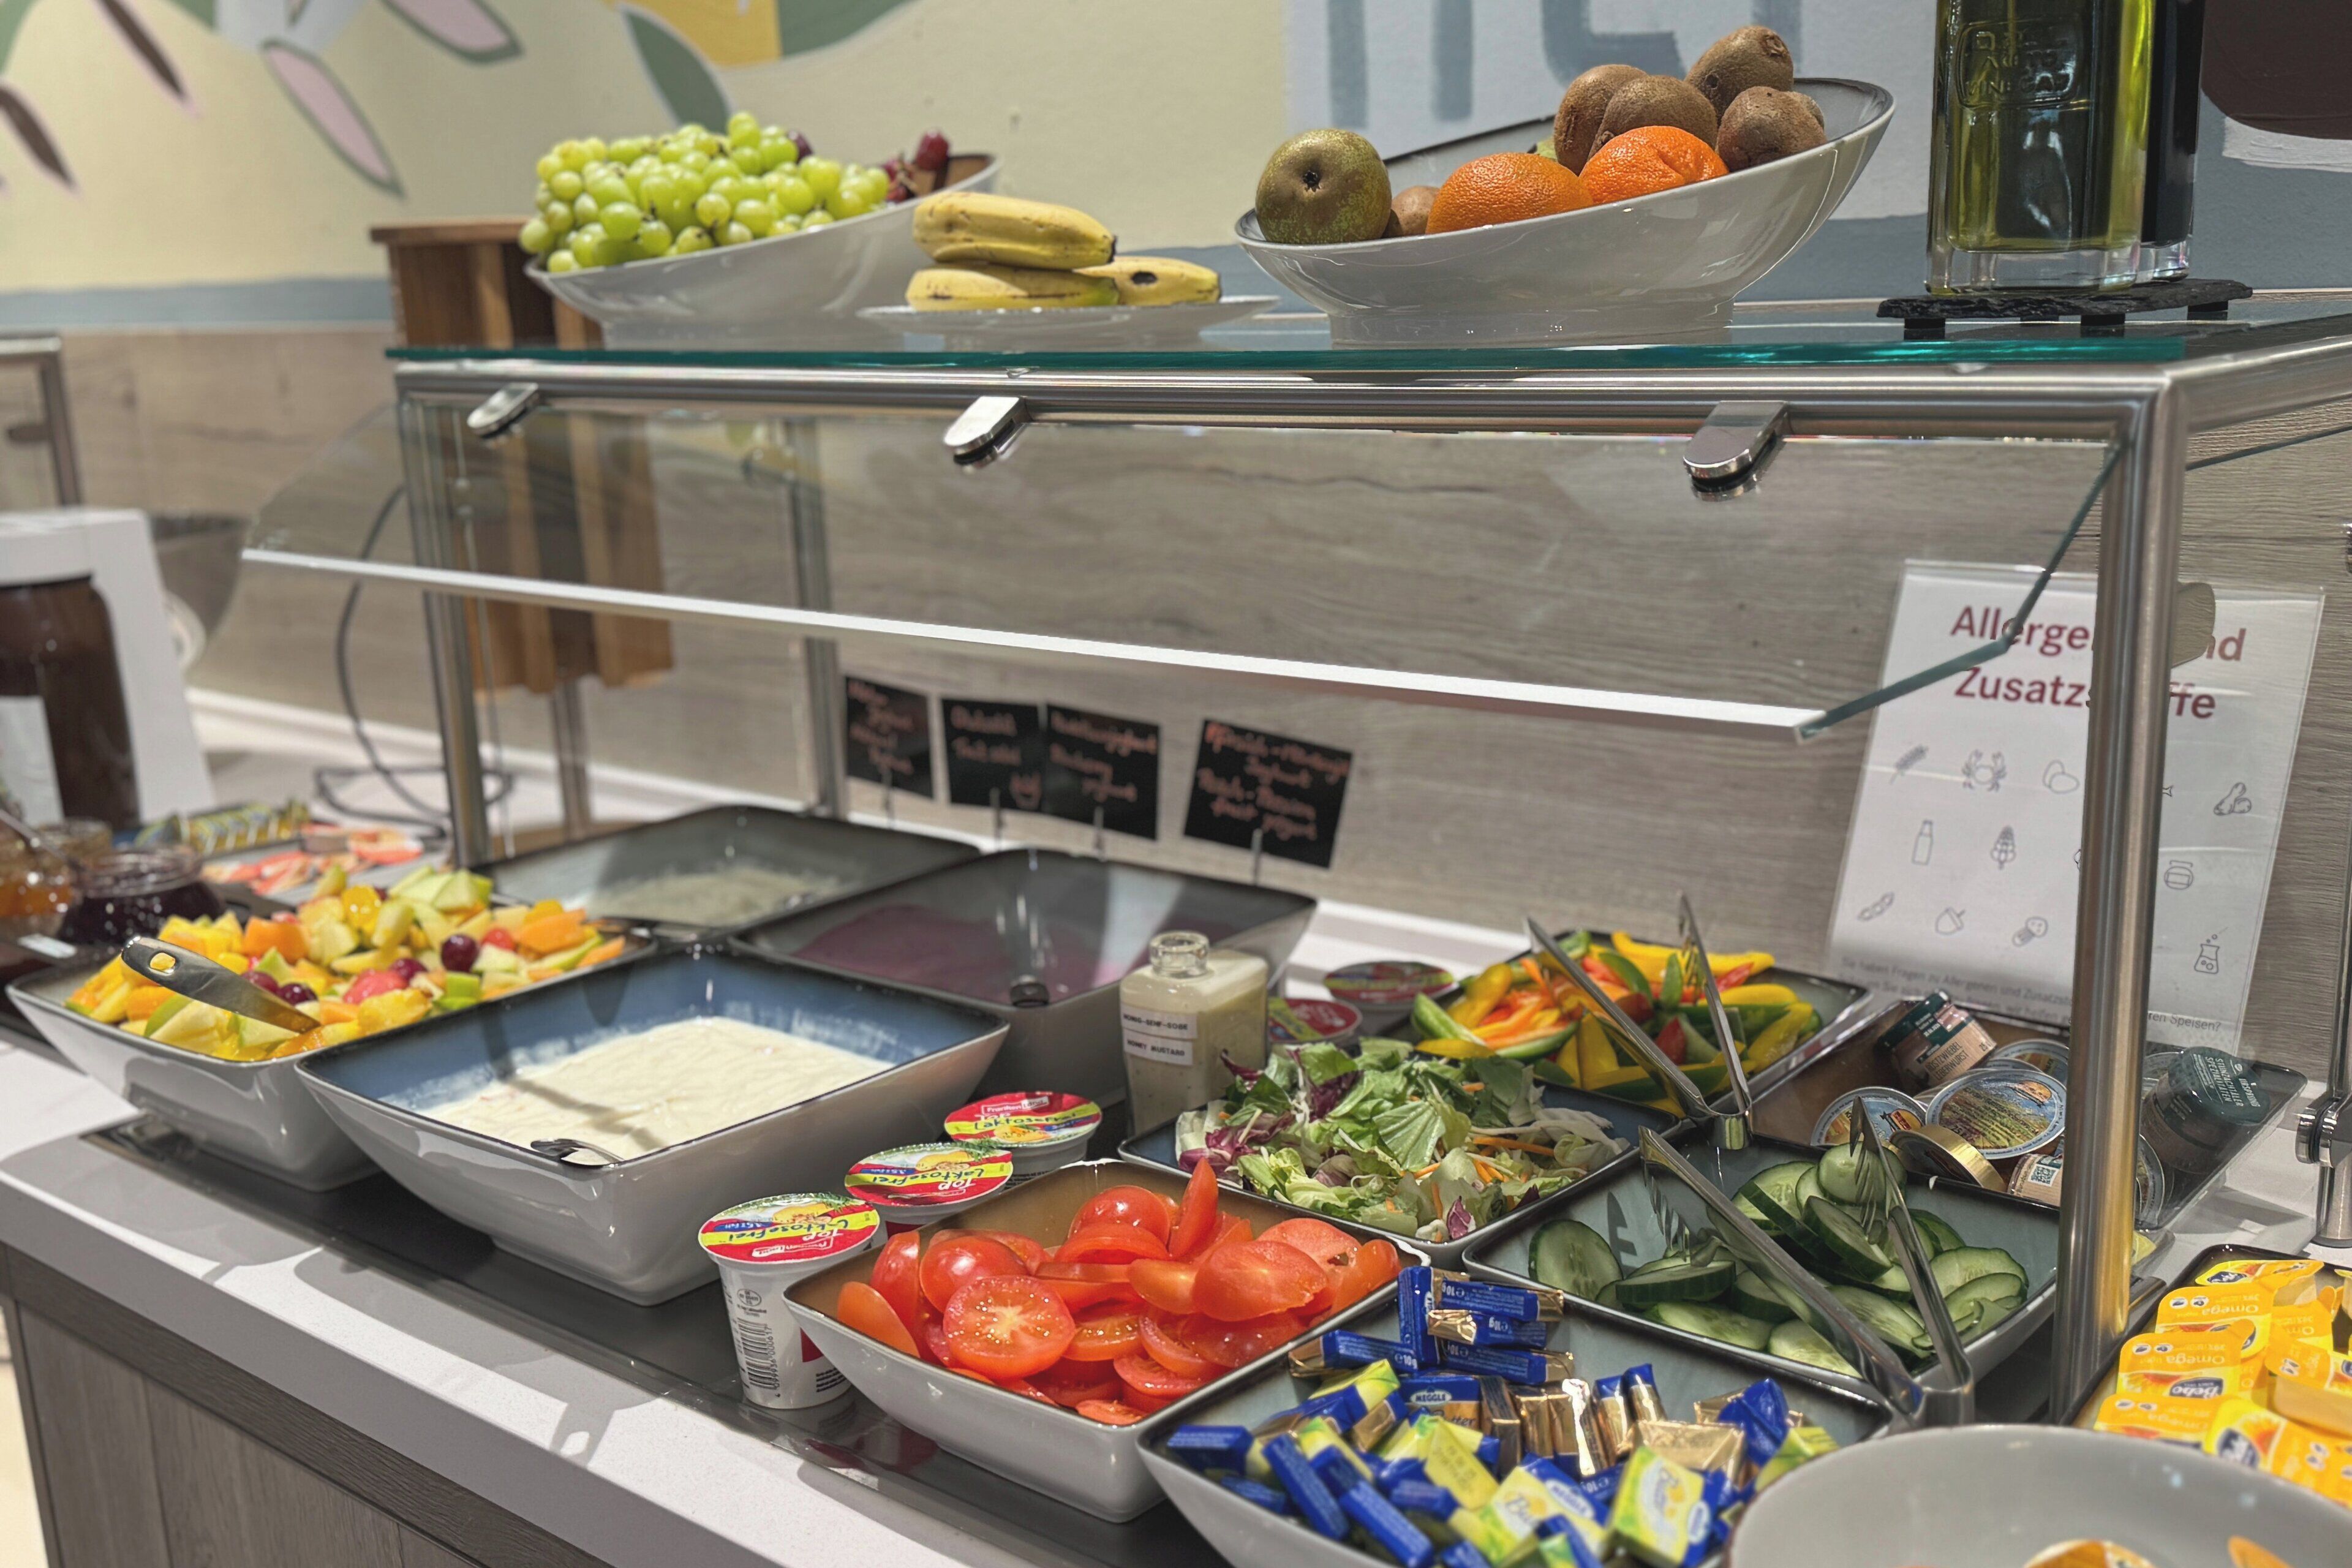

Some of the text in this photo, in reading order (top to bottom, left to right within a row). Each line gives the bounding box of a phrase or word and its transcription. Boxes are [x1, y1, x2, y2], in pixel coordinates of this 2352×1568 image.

[1951, 606, 2092, 657] Allerge
[1151, 1046, 1185, 1056] MUSTARD
[2203, 1304, 2260, 1316] Omega
[2166, 1353, 2225, 1365] Omega
[1414, 1393, 1447, 1402] MEGGLE
